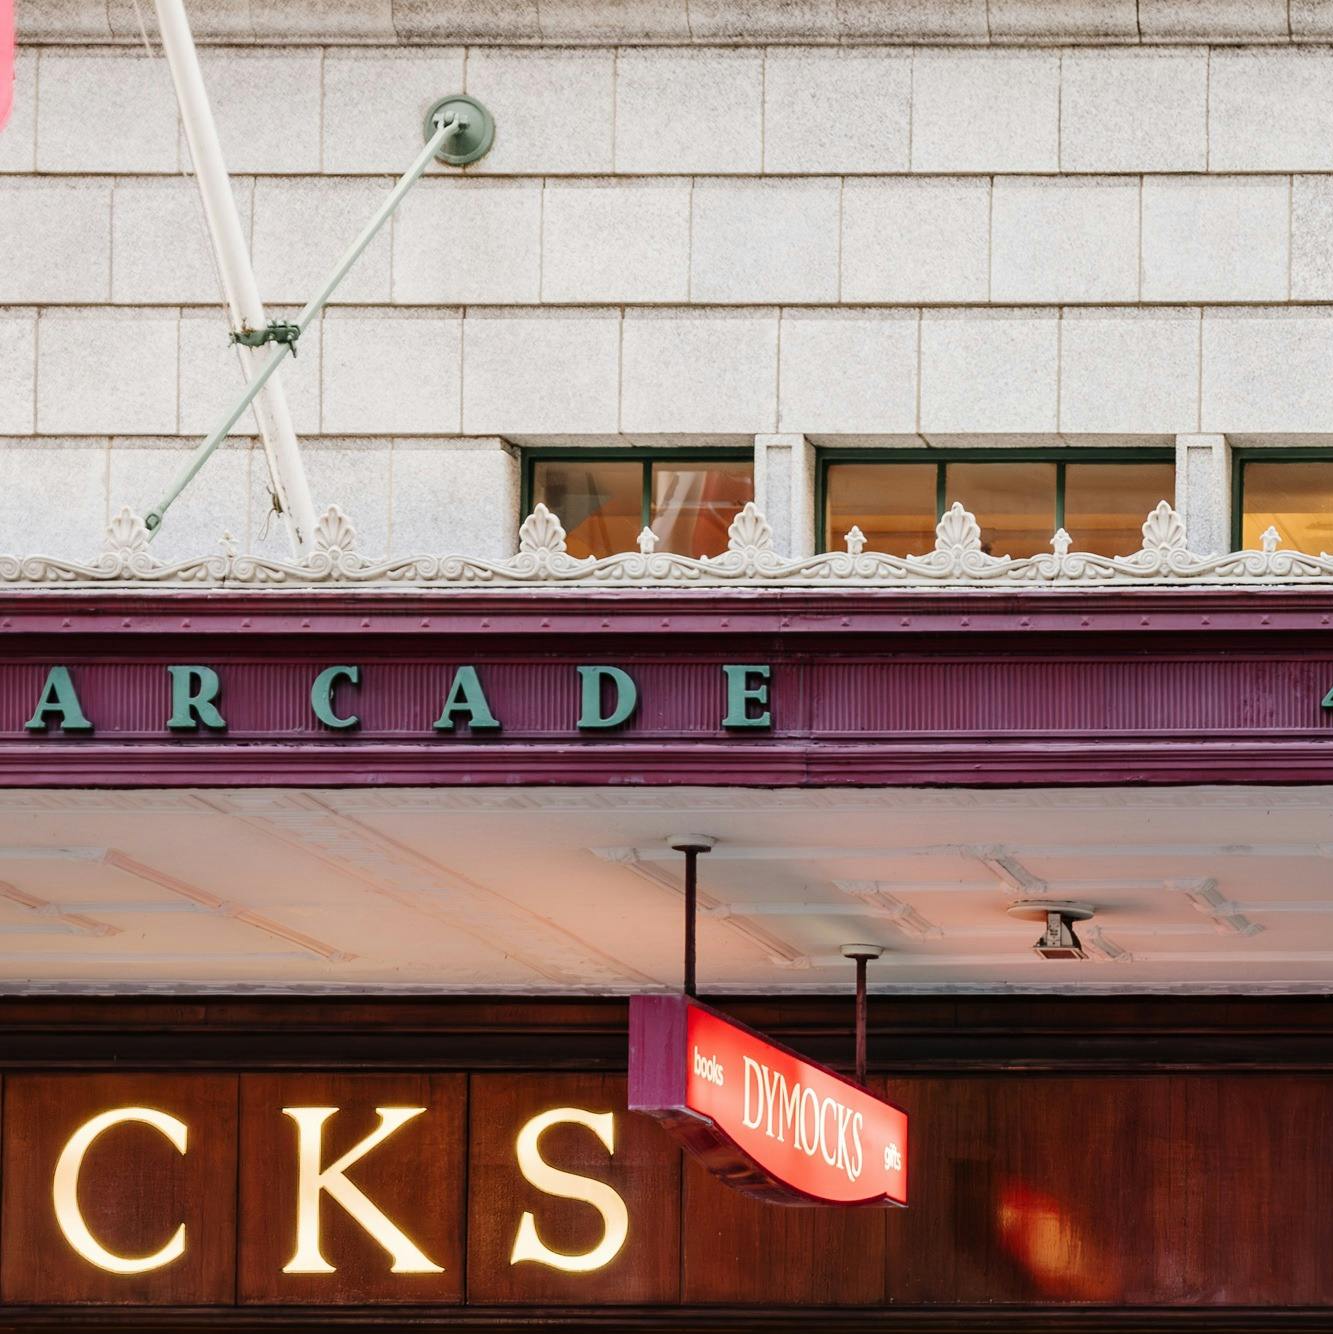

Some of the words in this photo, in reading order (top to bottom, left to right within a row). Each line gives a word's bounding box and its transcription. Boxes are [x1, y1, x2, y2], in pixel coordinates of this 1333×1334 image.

[25, 664, 773, 730] ARCADE
[693, 1045, 724, 1087] books
[742, 1056, 863, 1182] DYMOCKS
[52, 1105, 629, 1275] CKS
[883, 1143, 902, 1171] gifts
